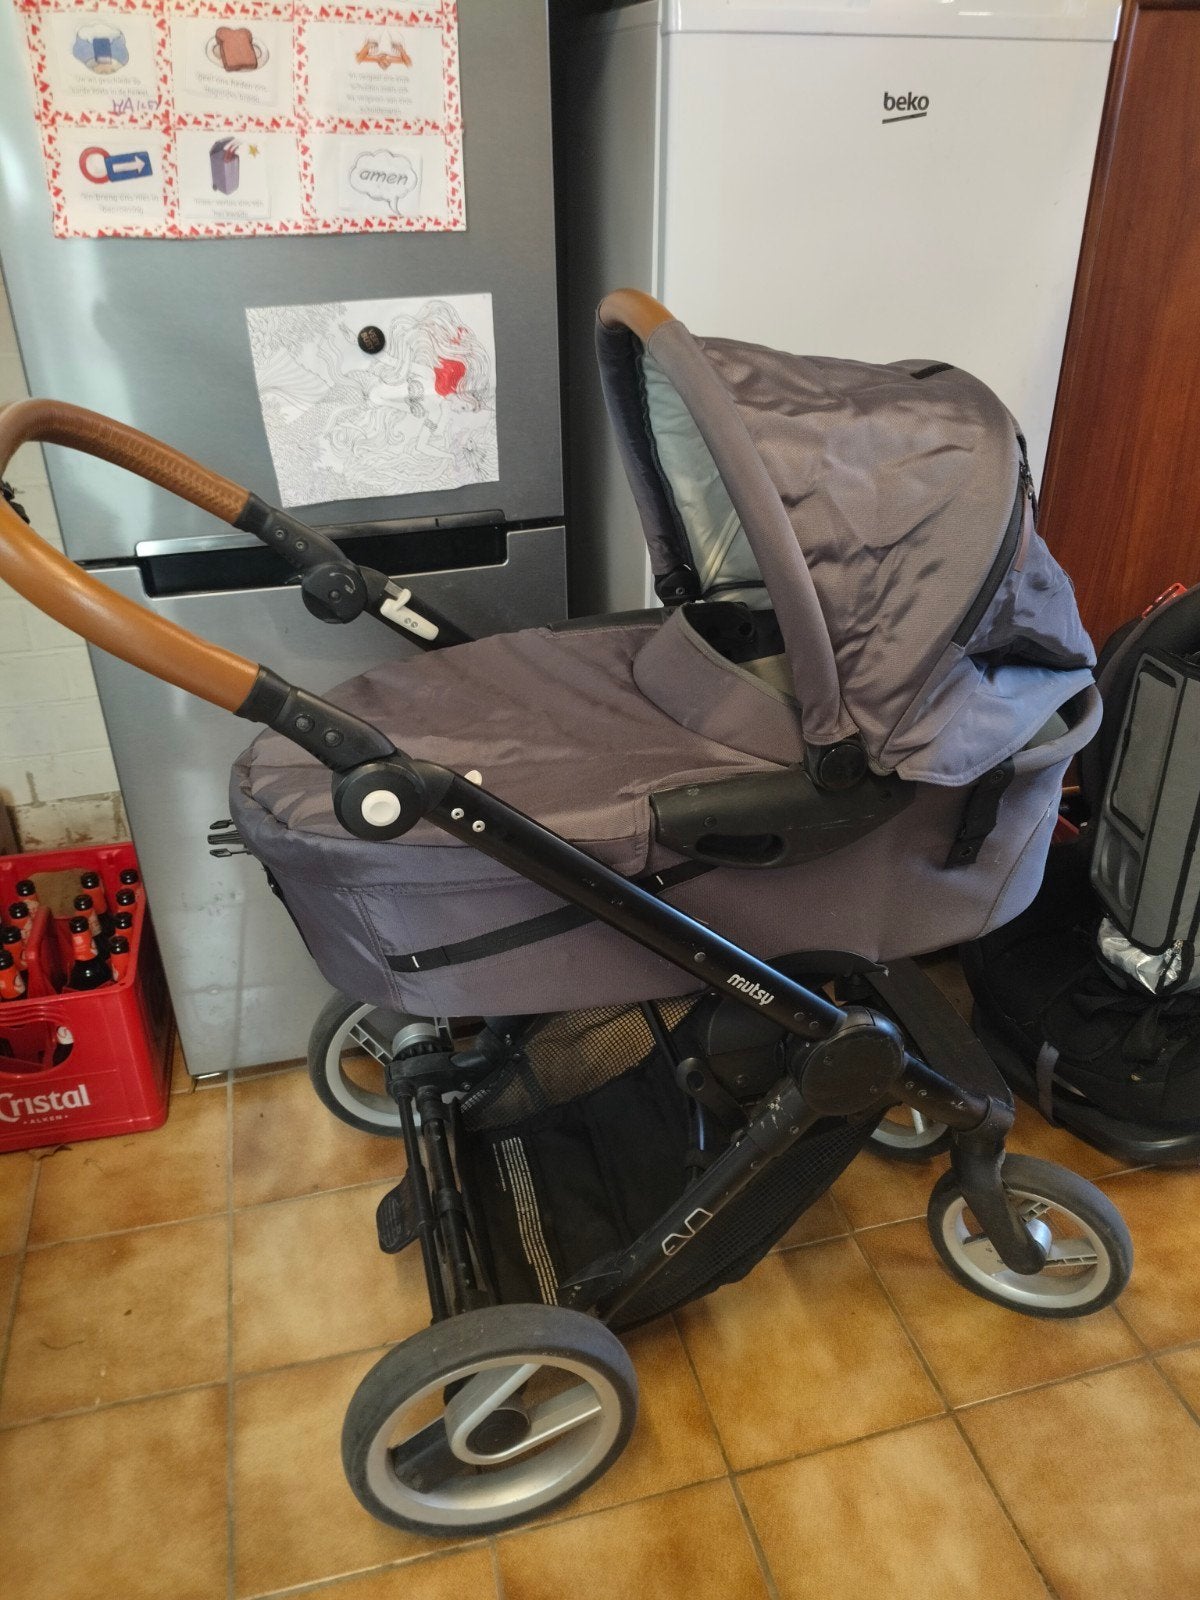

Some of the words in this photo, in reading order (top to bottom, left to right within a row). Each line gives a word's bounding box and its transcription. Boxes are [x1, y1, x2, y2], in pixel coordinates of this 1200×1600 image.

[883, 91, 930, 111] beko
[359, 170, 408, 186] amen
[726, 973, 775, 1006] mutsy
[0, 1084, 91, 1123] Cristal
